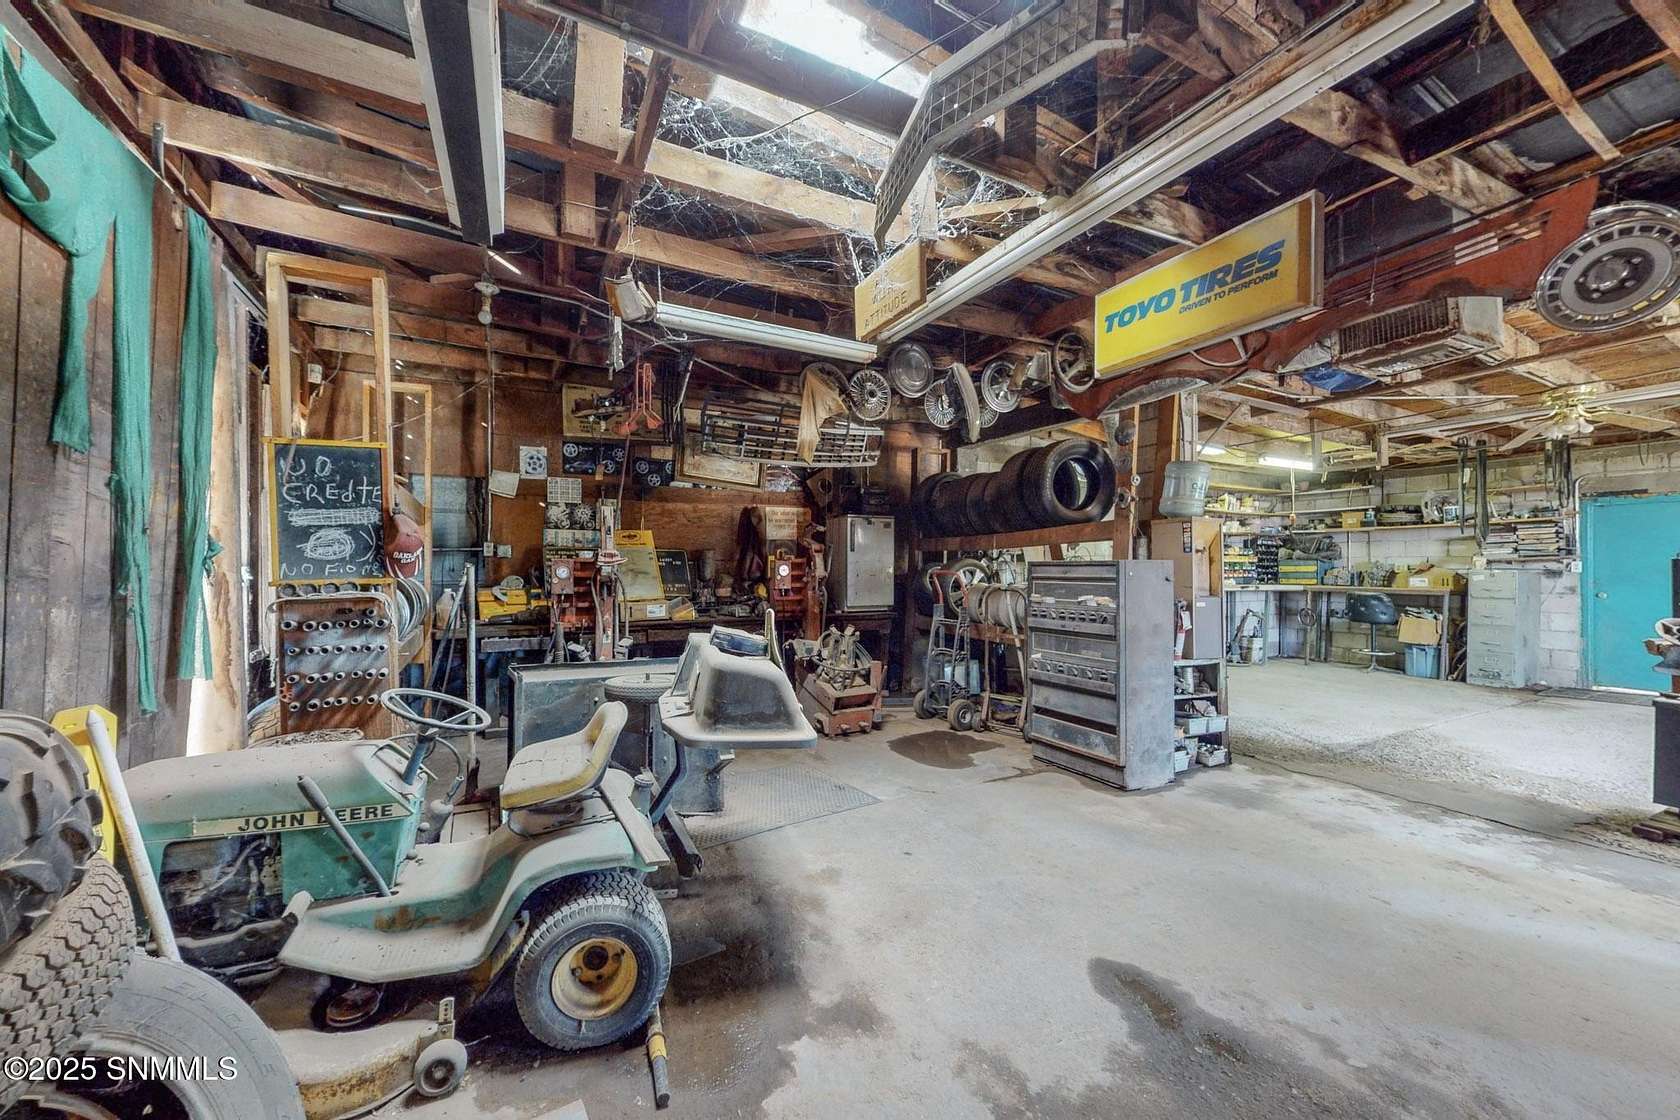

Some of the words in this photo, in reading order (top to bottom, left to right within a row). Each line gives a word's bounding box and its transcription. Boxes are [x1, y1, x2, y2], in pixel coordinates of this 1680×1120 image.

[1104, 288, 1177, 334] TOYO
[1180, 239, 1285, 305] TIRES
[1179, 296, 1212, 314] DRIVEN
[1214, 290, 1226, 301] TO
[1227, 269, 1279, 296] PERFORM
[280, 562, 314, 580] NO
[237, 813, 305, 832] JOHN
